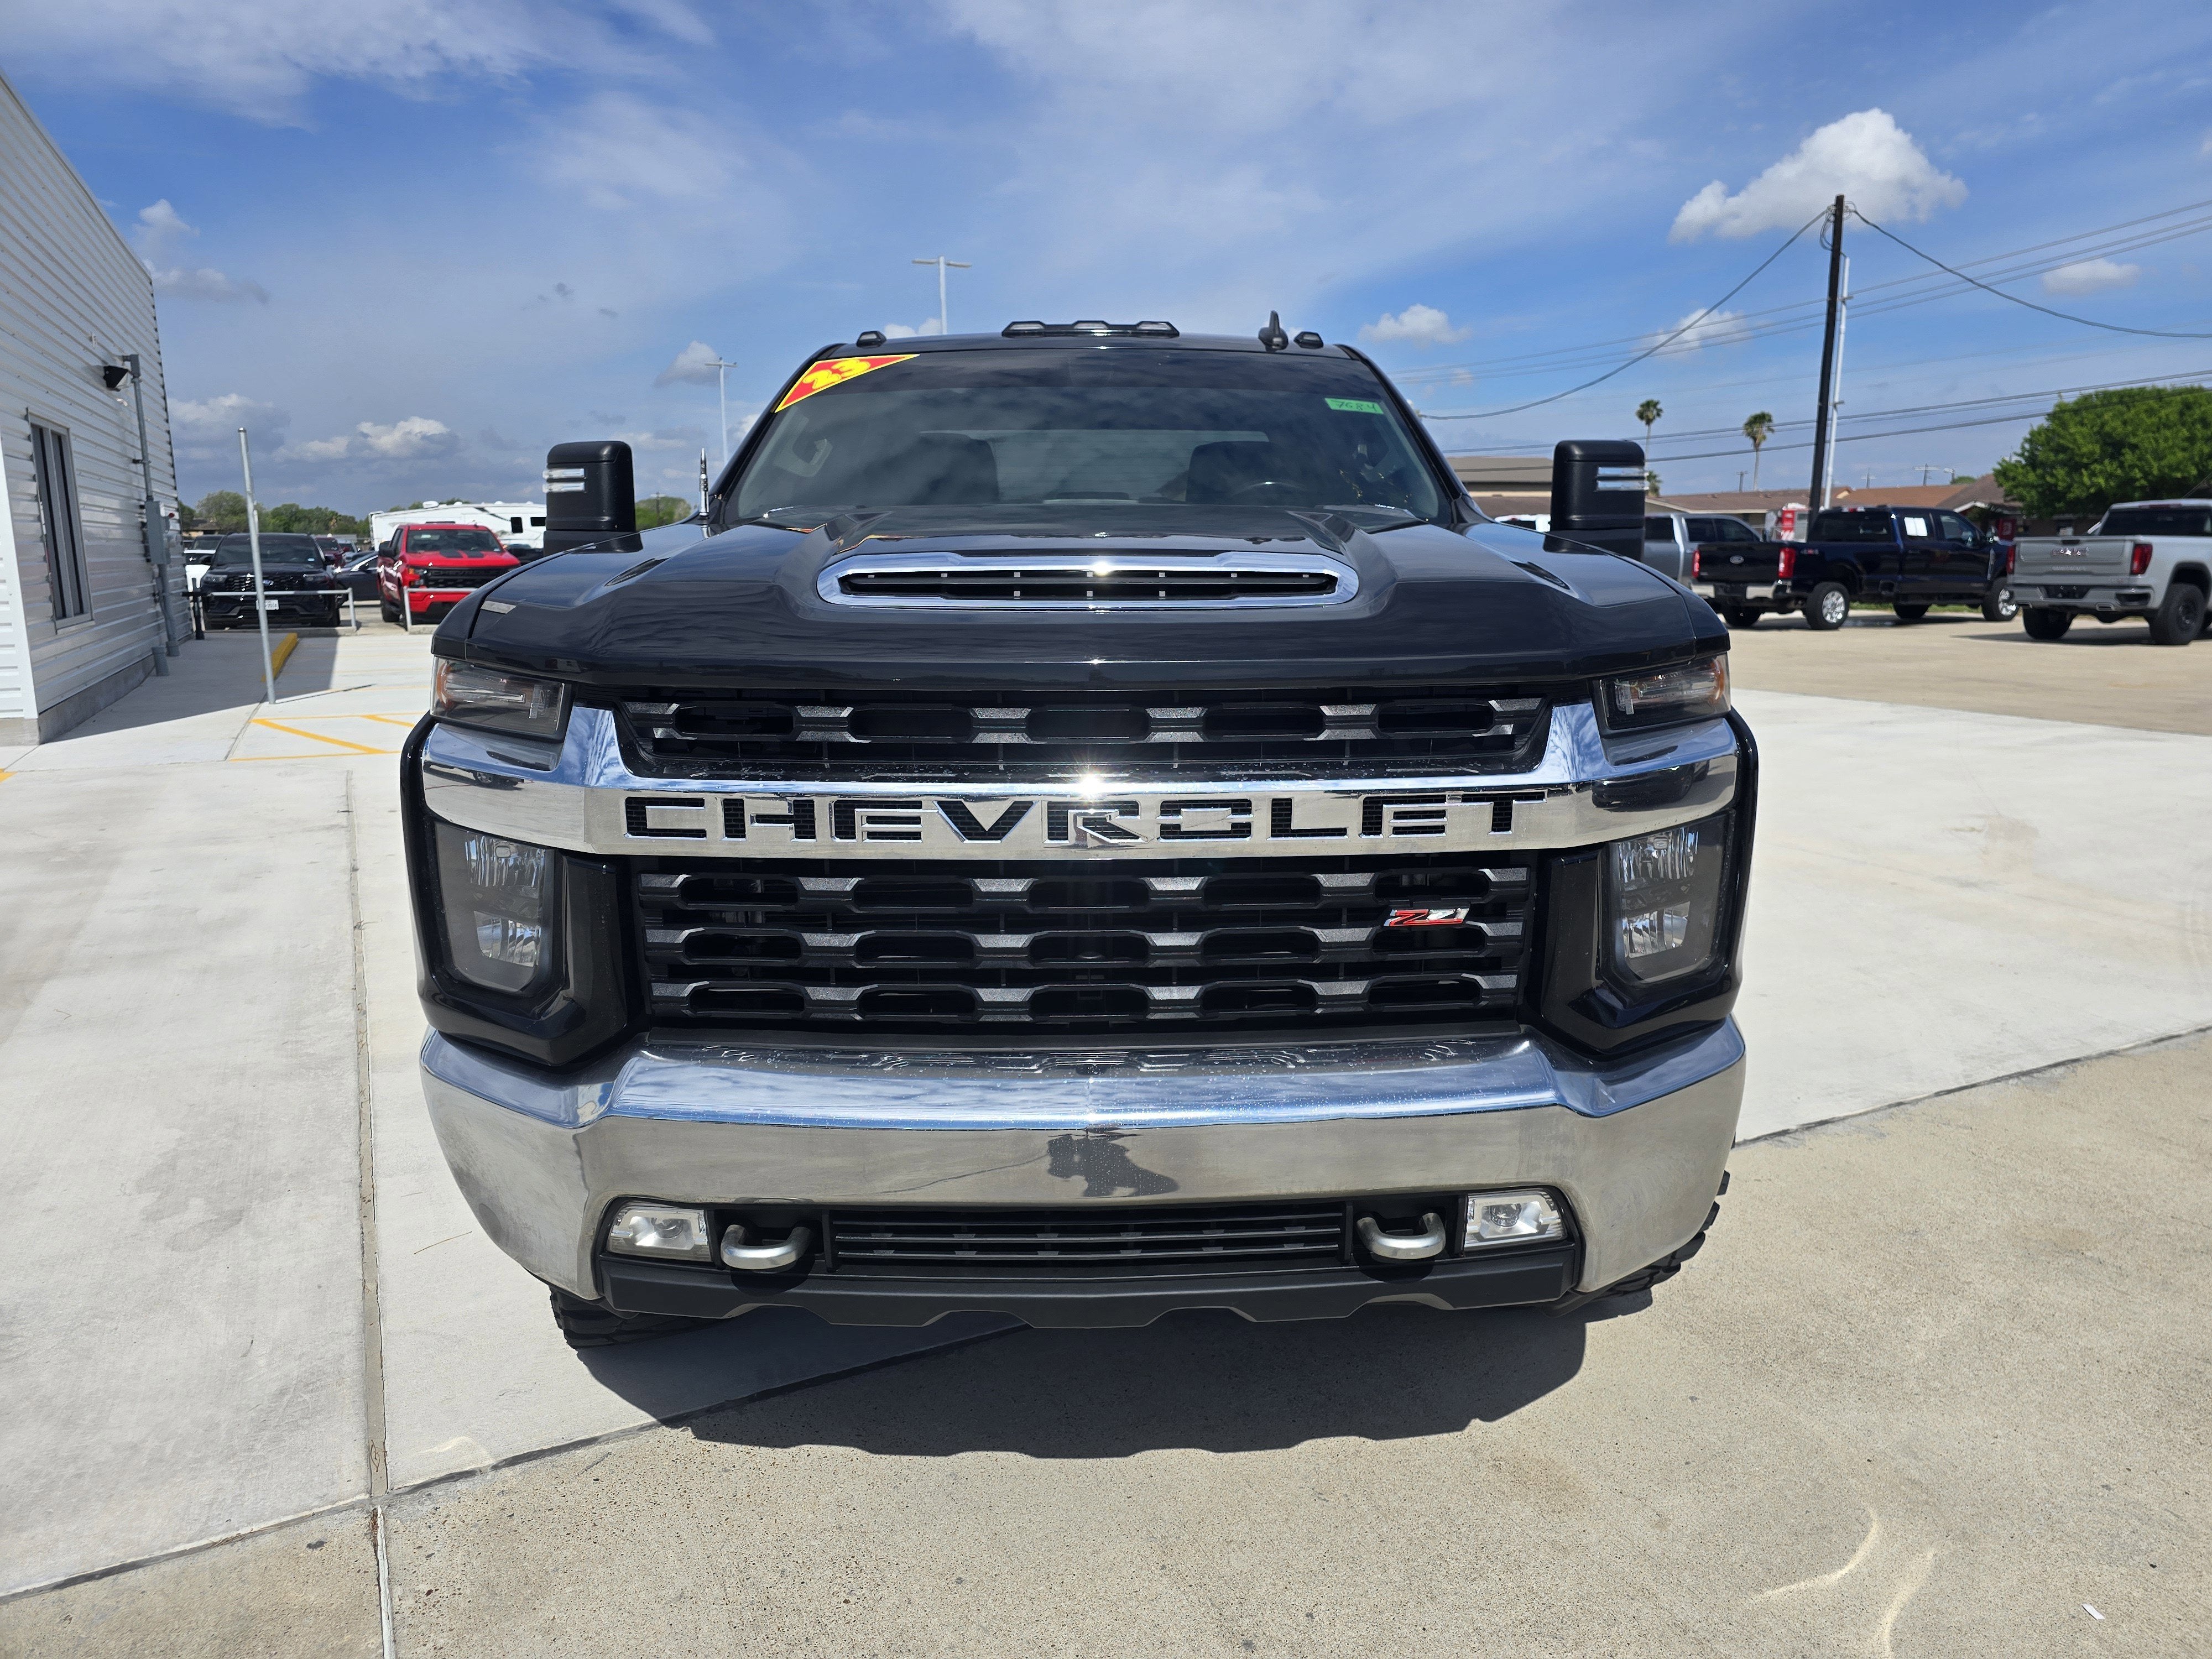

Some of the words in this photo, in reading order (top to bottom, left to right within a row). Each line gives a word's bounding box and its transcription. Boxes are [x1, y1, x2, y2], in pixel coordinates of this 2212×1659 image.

[802, 359, 871, 389] 23
[624, 790, 1548, 844] CHEVROLET
[1384, 908, 1470, 926] Z71
